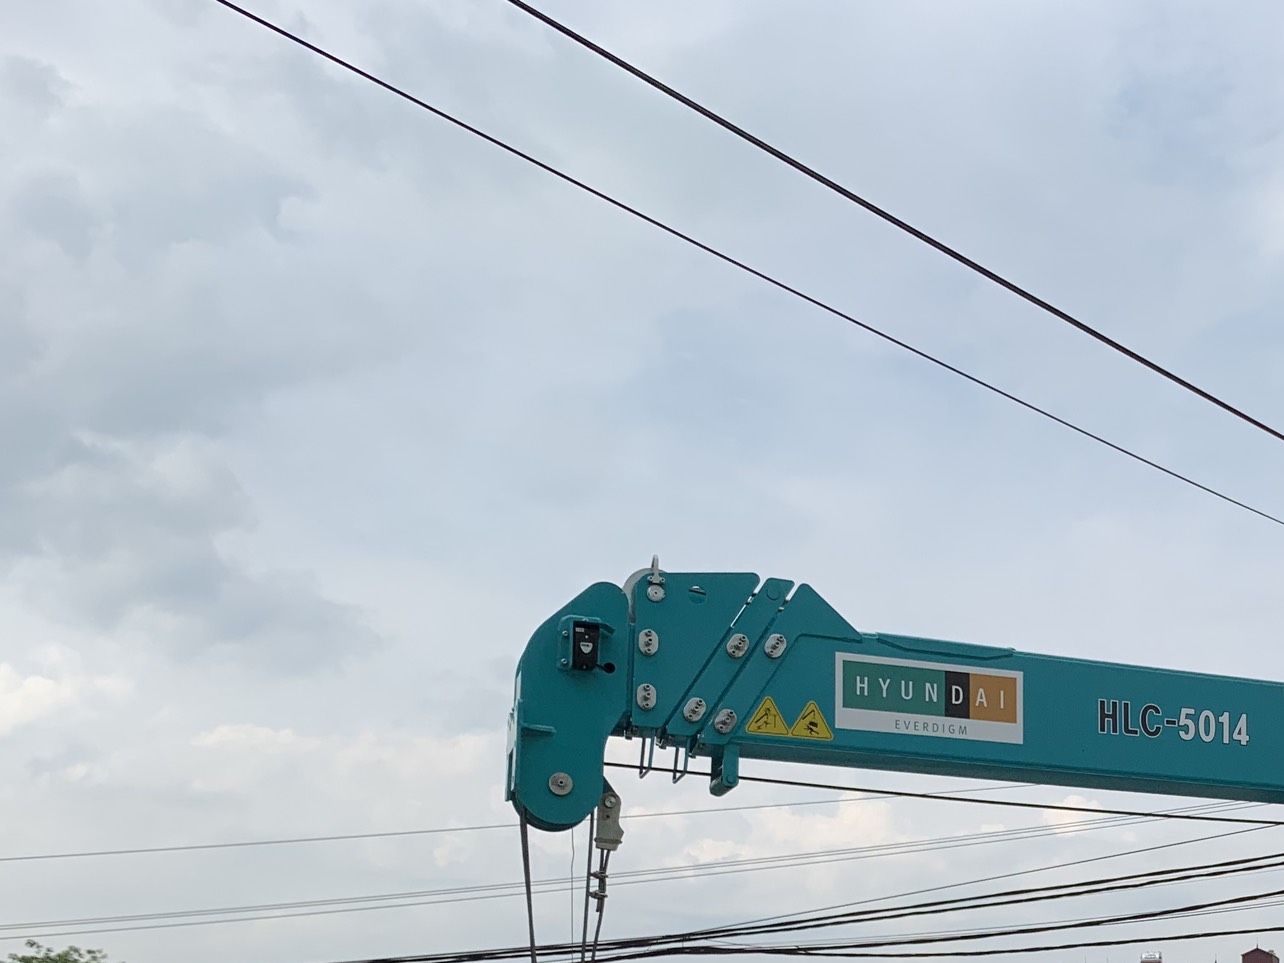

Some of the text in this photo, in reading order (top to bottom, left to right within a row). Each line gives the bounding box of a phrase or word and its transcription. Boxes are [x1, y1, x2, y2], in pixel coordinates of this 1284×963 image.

[855, 675, 1006, 709] HYUNDAI
[894, 719, 968, 735] EVERDIGM
[1098, 699, 1250, 746] HLC-5014
